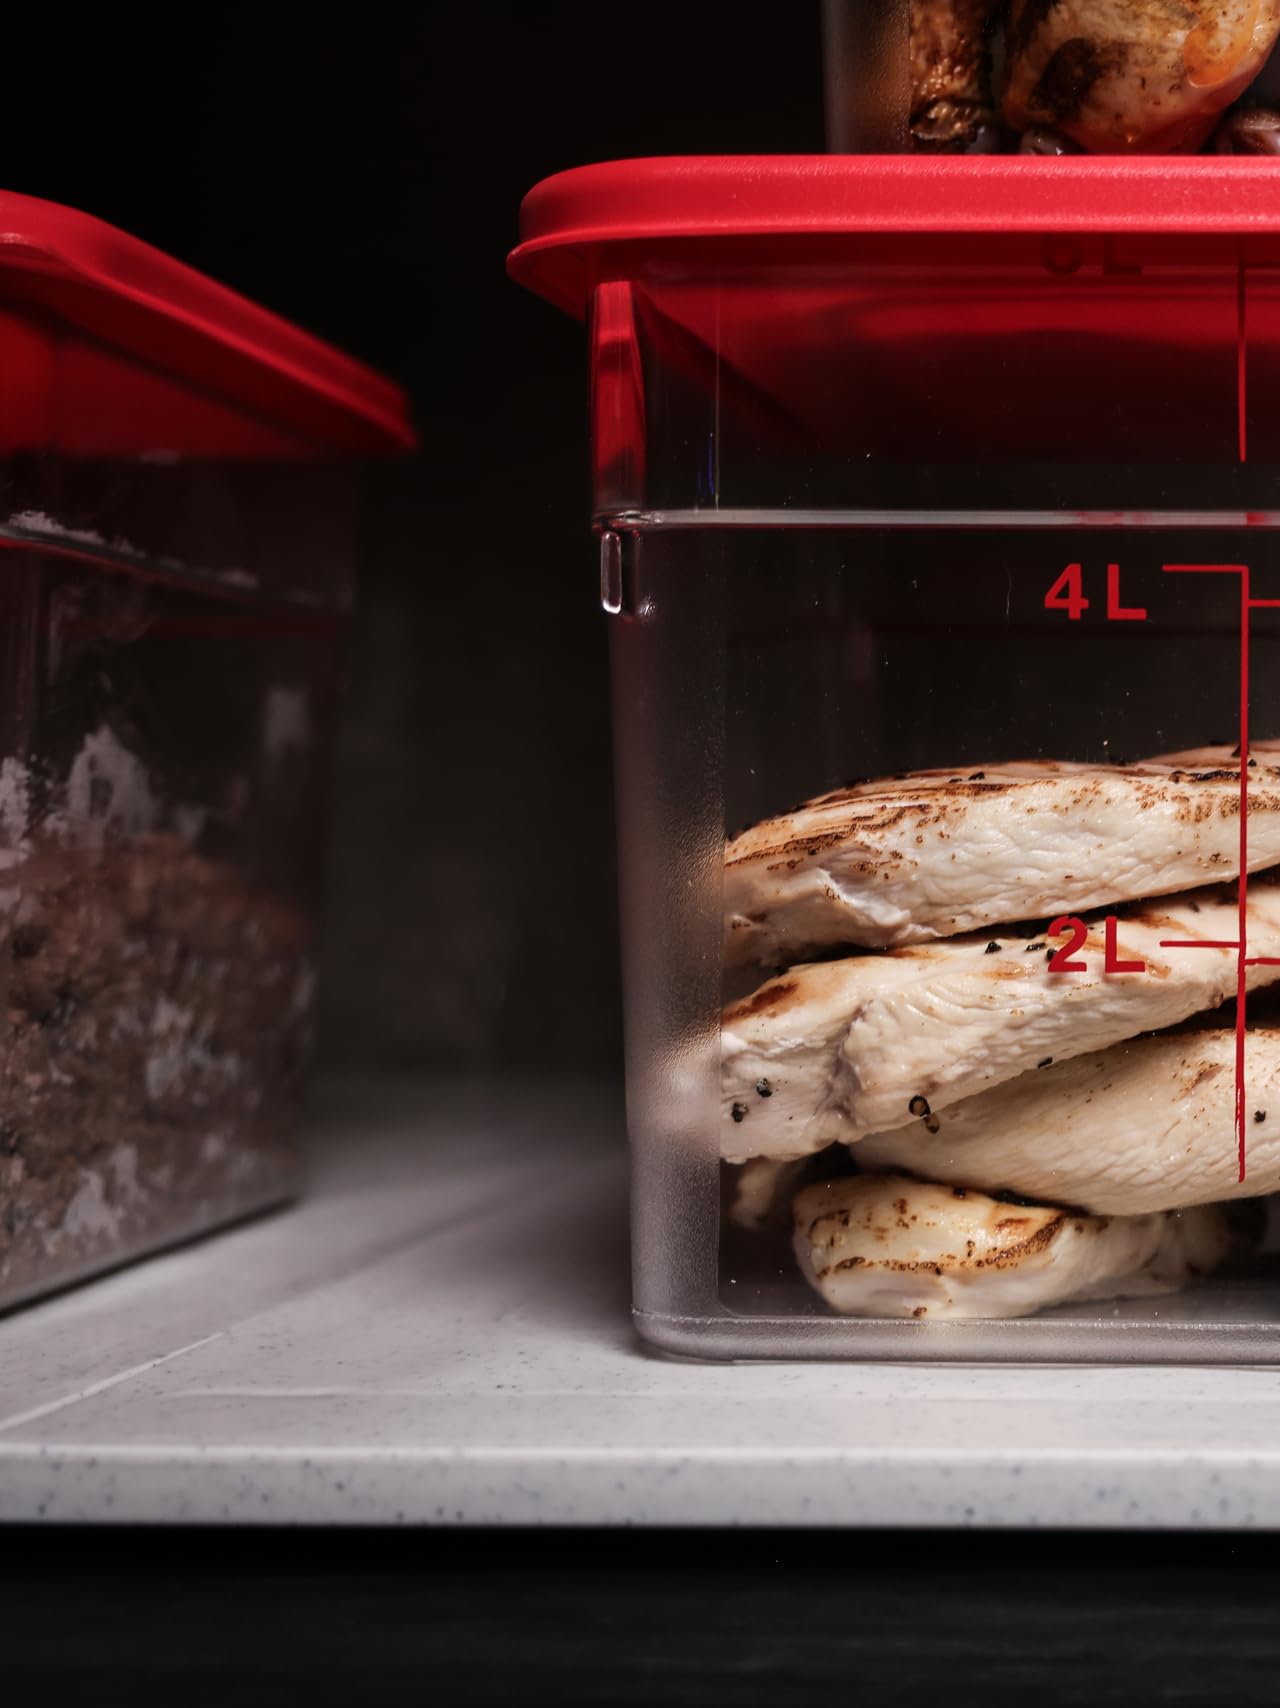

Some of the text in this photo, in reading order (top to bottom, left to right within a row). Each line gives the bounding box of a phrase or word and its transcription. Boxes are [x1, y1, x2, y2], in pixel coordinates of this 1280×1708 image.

[1040, 233, 1143, 277] 6 L
[1044, 563, 1147, 620] 4 L
[1047, 915, 1145, 973] 2 L
